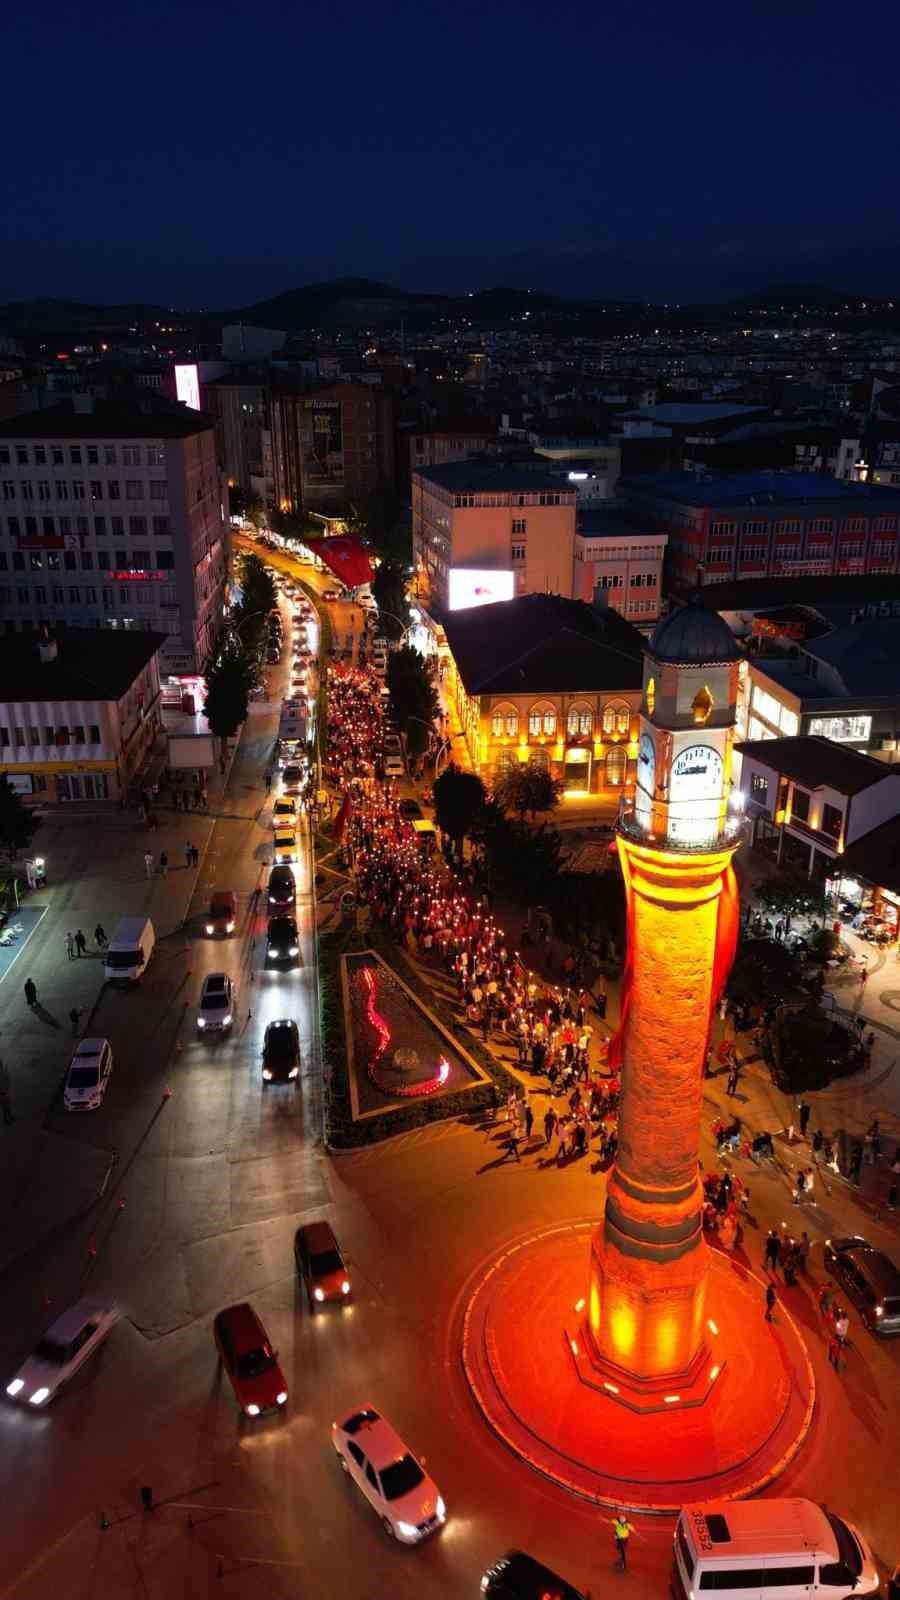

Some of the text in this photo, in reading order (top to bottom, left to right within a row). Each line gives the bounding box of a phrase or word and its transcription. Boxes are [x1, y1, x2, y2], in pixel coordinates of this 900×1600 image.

[685, 753, 693, 761] 11
[695, 749, 704, 757] 12
[677, 760, 686, 769] 10
[691, 1511, 713, 1551] 38552
